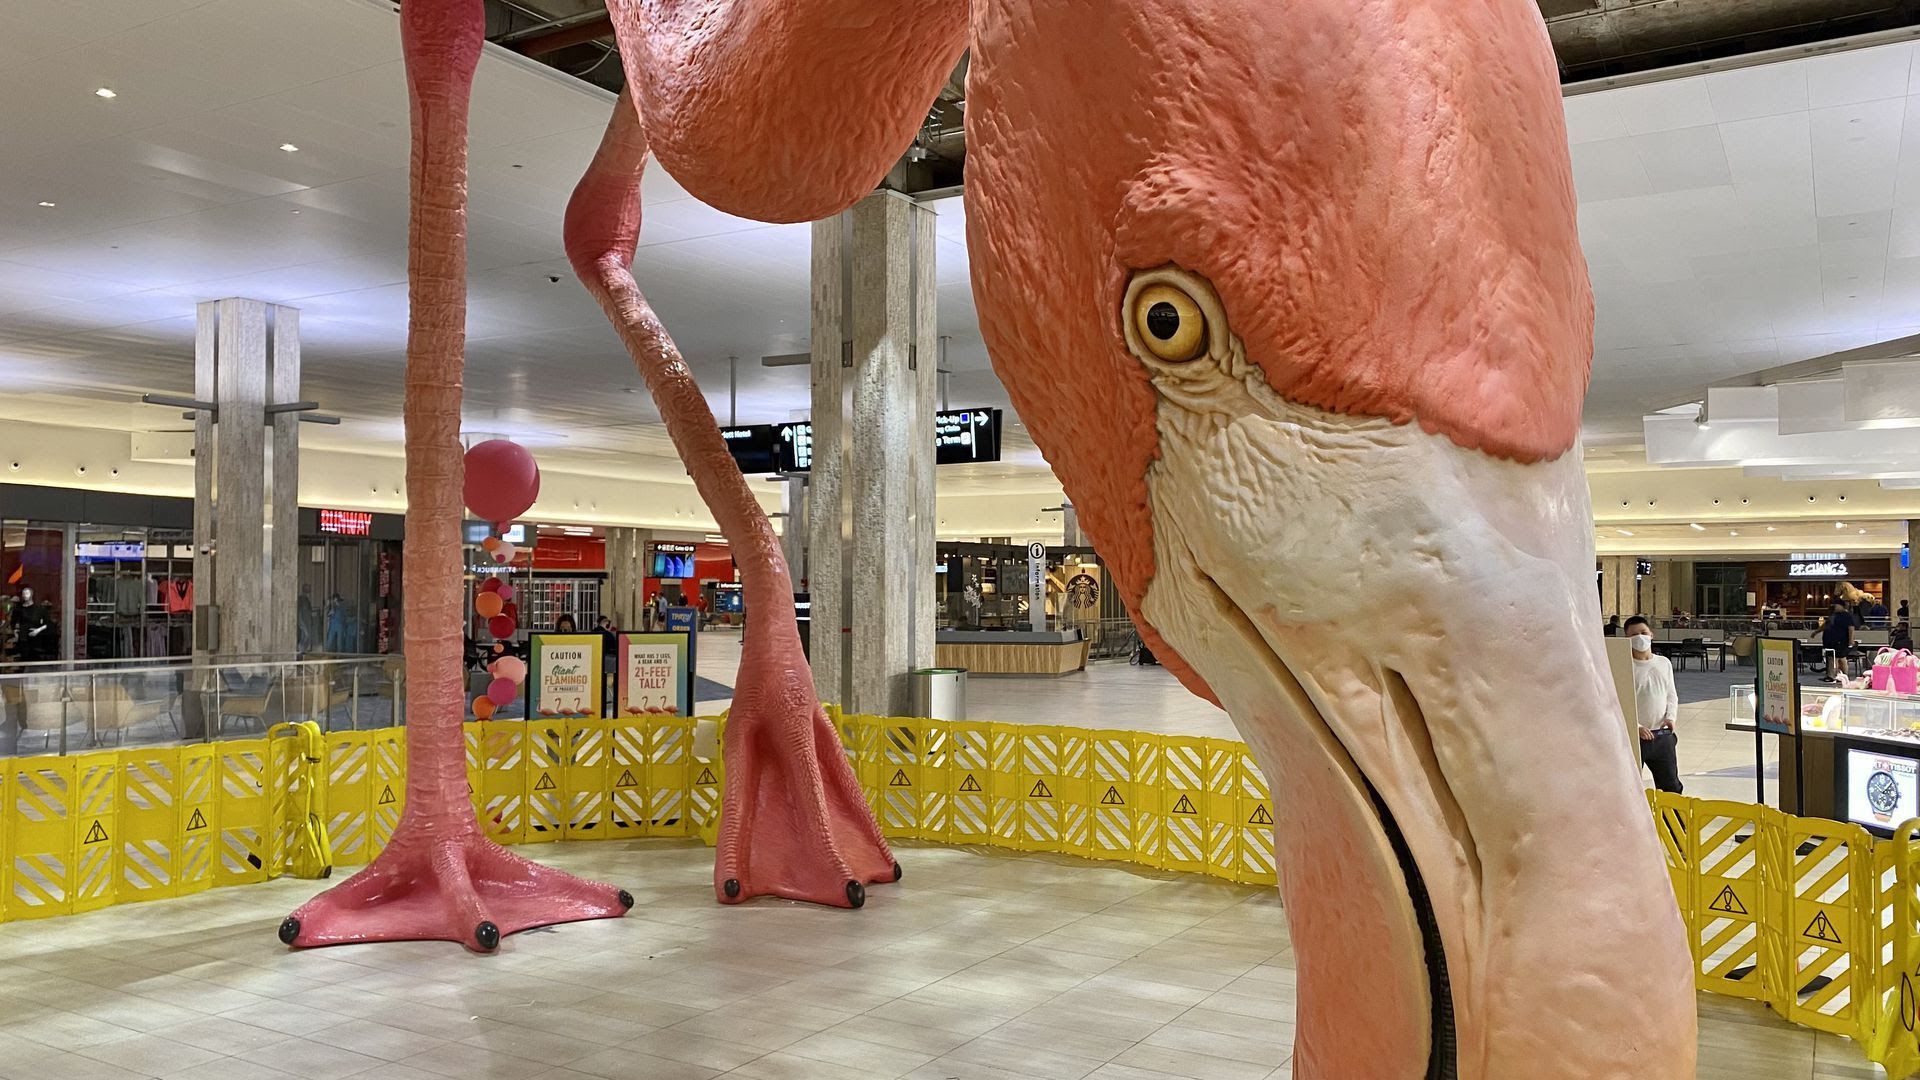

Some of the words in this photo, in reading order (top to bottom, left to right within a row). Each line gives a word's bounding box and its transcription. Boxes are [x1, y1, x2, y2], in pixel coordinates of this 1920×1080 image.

[550, 651, 582, 660] CAUTION
[1767, 657, 1784, 666] CAUTION
[551, 664, 581, 677] Giant
[634, 666, 672, 678] 21-FEET
[544, 675, 588, 685] FLAMINGO
[639, 677, 666, 689] TALL?
[1890, 763, 1917, 774] TISSOT
